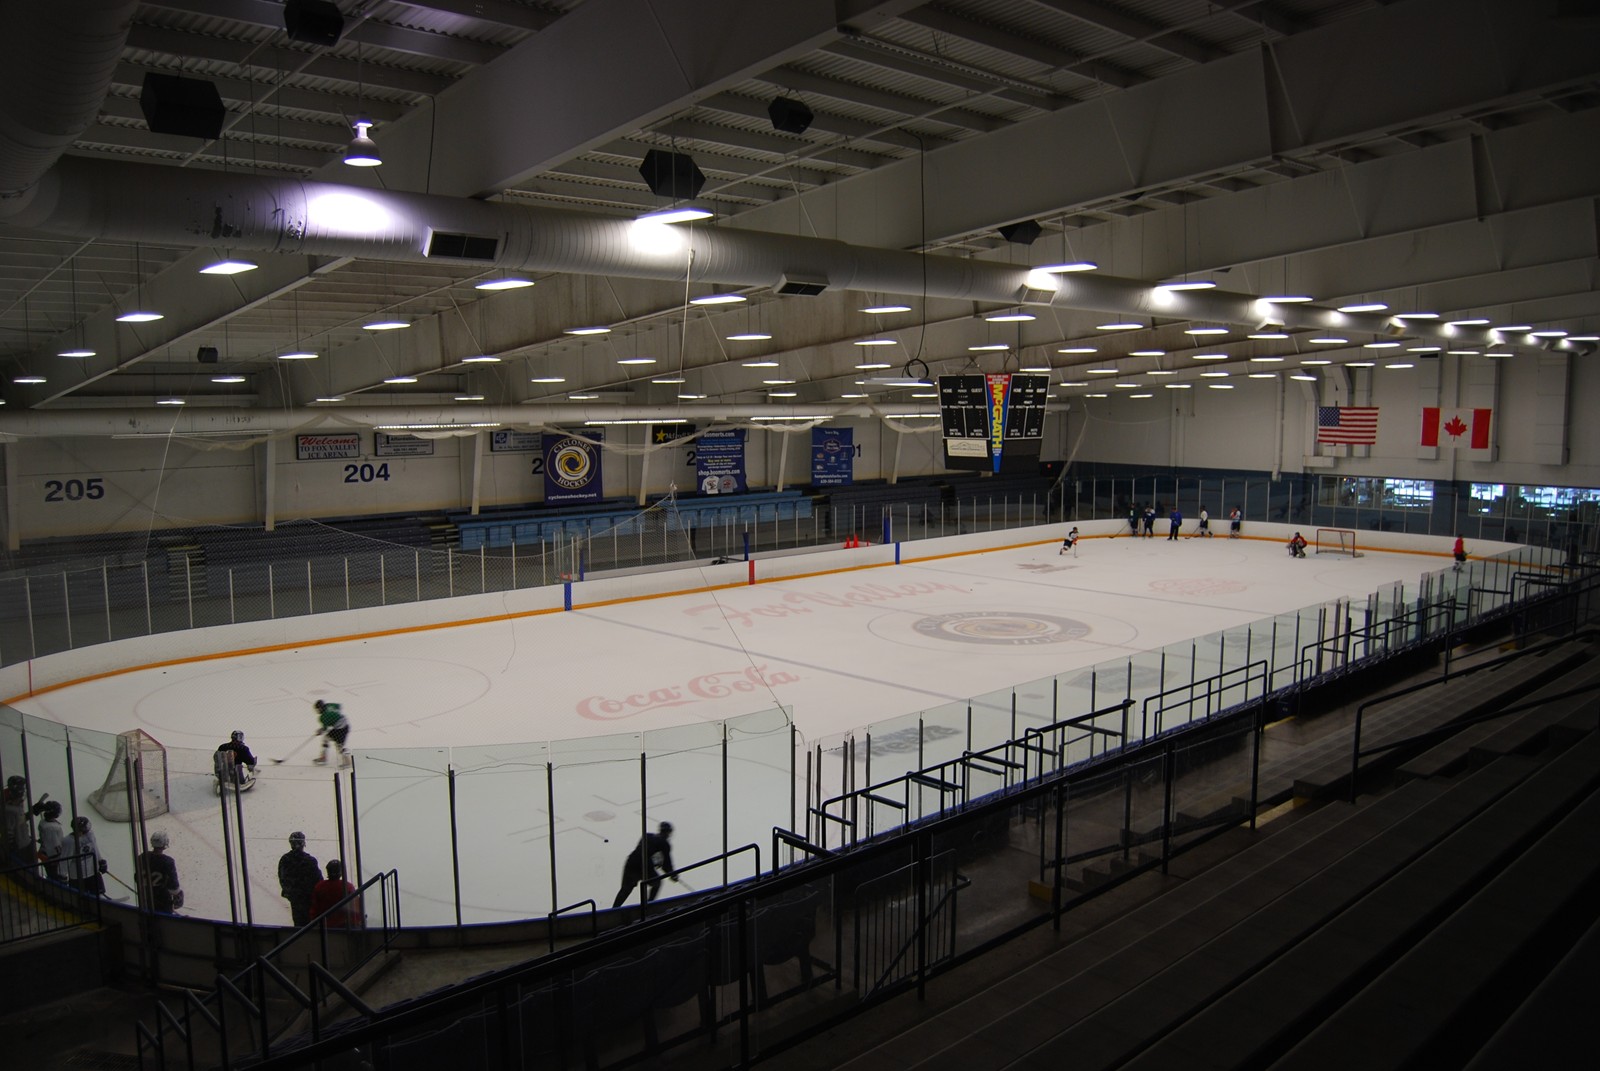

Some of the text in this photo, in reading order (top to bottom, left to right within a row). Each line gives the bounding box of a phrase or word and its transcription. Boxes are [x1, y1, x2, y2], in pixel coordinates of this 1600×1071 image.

[300, 436, 357, 446] Welcome
[553, 439, 591, 454] CYCLONES
[344, 463, 390, 483] 204
[44, 478, 105, 502] 205
[557, 476, 589, 488] HOCKEY
[575, 664, 800, 721] Coca-Cola
